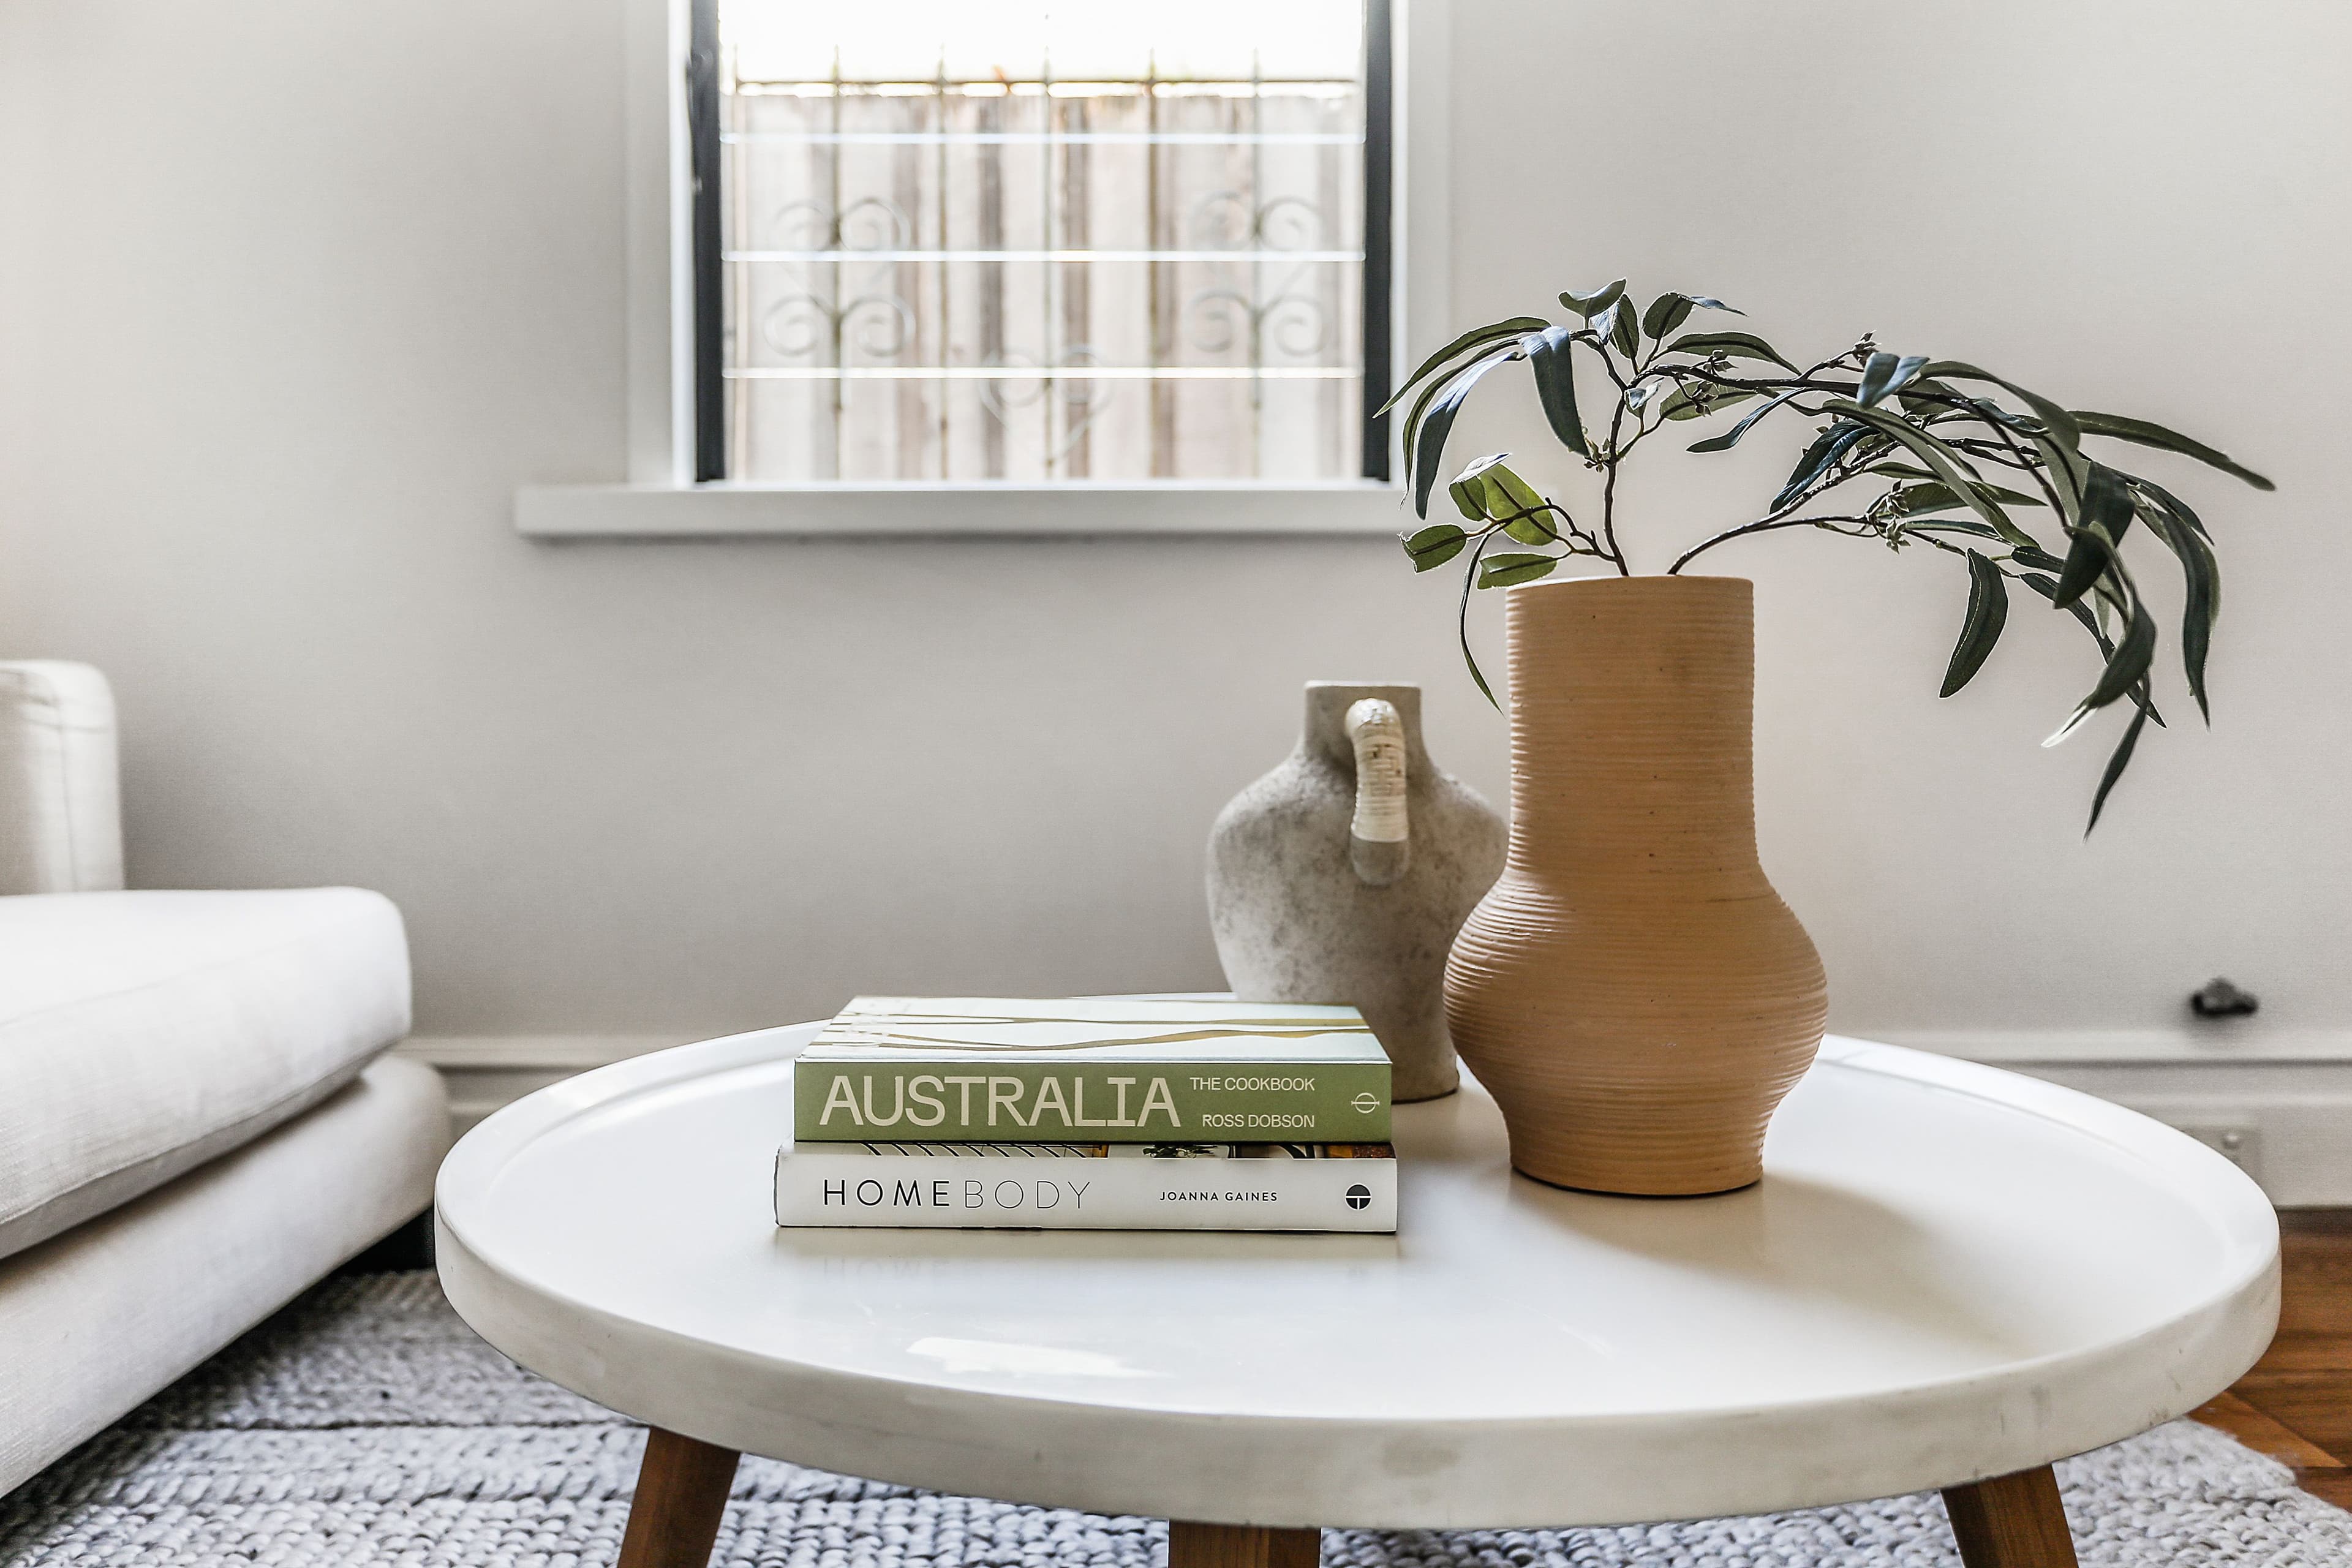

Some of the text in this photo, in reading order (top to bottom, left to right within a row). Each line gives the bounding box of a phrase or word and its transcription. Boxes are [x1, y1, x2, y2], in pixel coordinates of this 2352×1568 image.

[1189, 1077, 1315, 1091] THE COOKBOOK
[820, 1076, 1181, 1128] AUSTRALIA
[1202, 1114, 1315, 1128] ROSS DOBSON
[823, 1179, 1091, 1210] HOMEBODY
[1159, 1191, 1277, 1202] JOANNA GAINES
